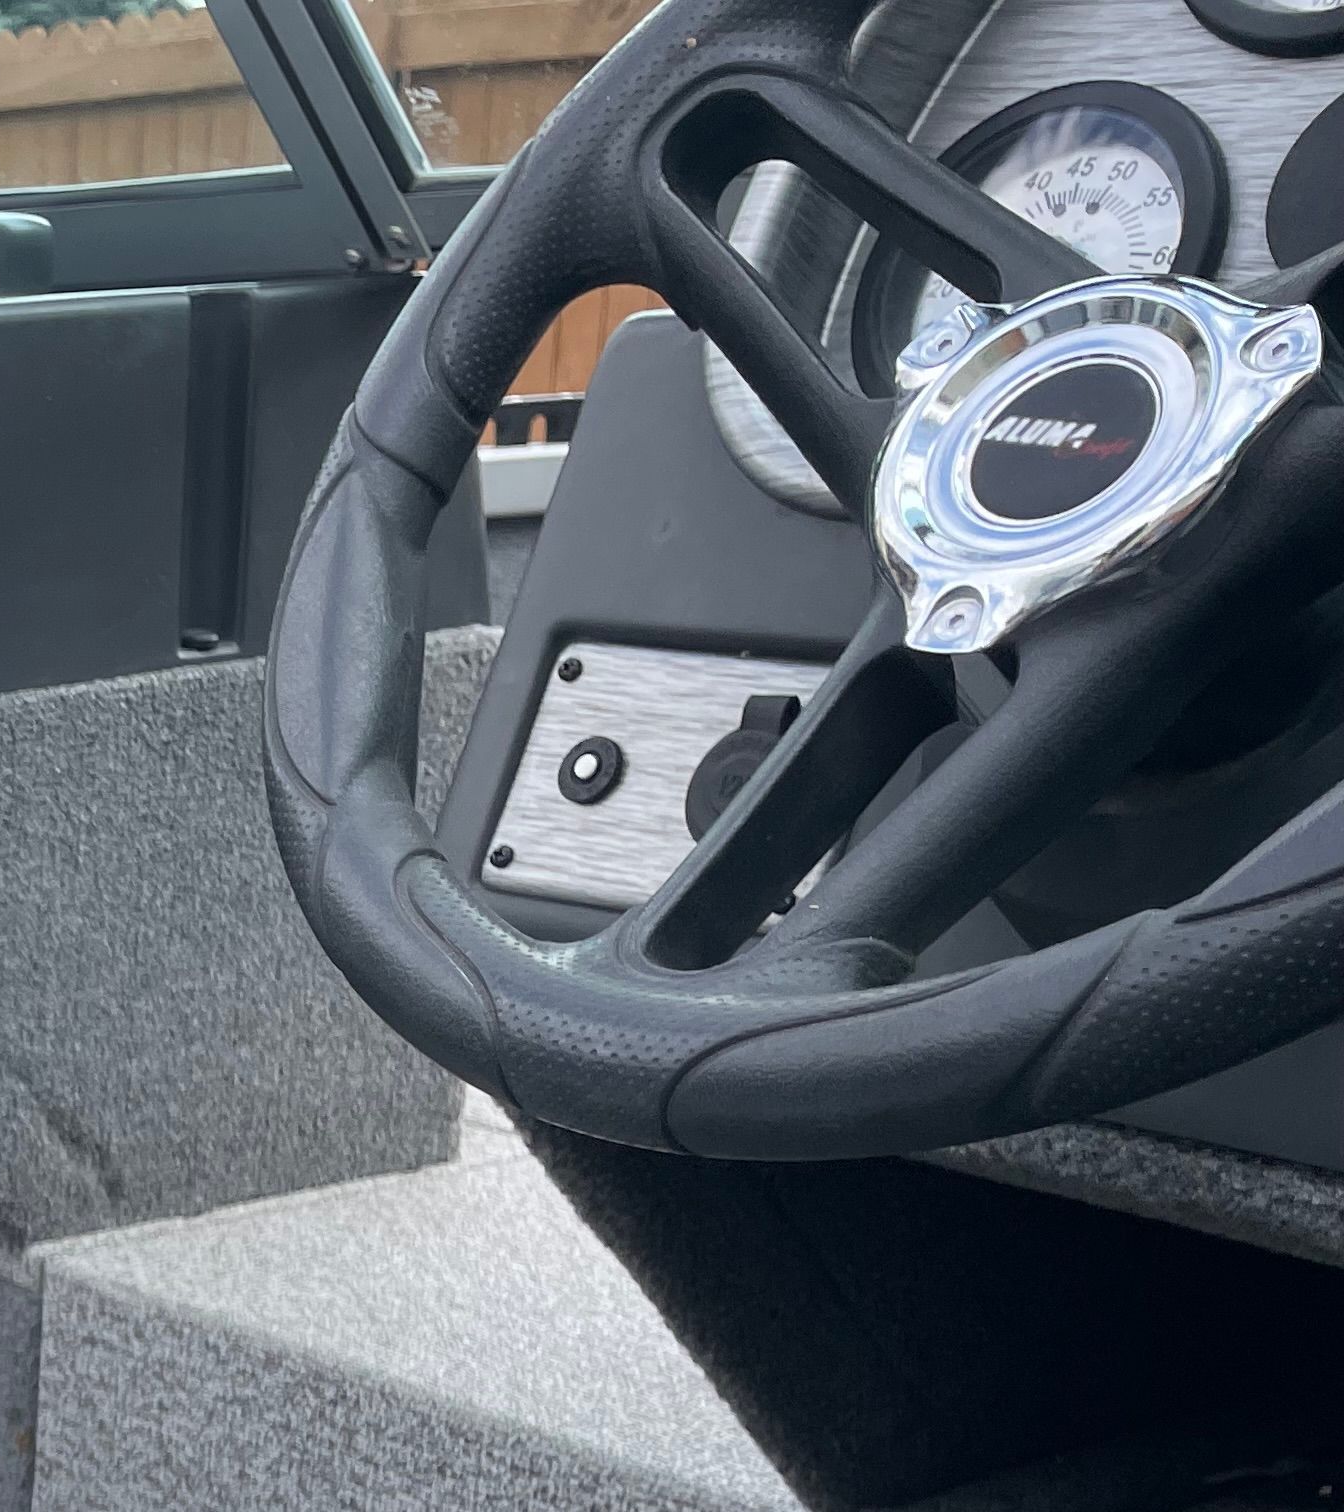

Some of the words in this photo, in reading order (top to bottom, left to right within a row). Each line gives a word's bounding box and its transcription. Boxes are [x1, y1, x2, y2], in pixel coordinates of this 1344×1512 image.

[1066, 156, 1099, 178] 45
[1107, 160, 1139, 182] 50
[1023, 171, 1053, 190] 40
[1143, 186, 1175, 208] 55
